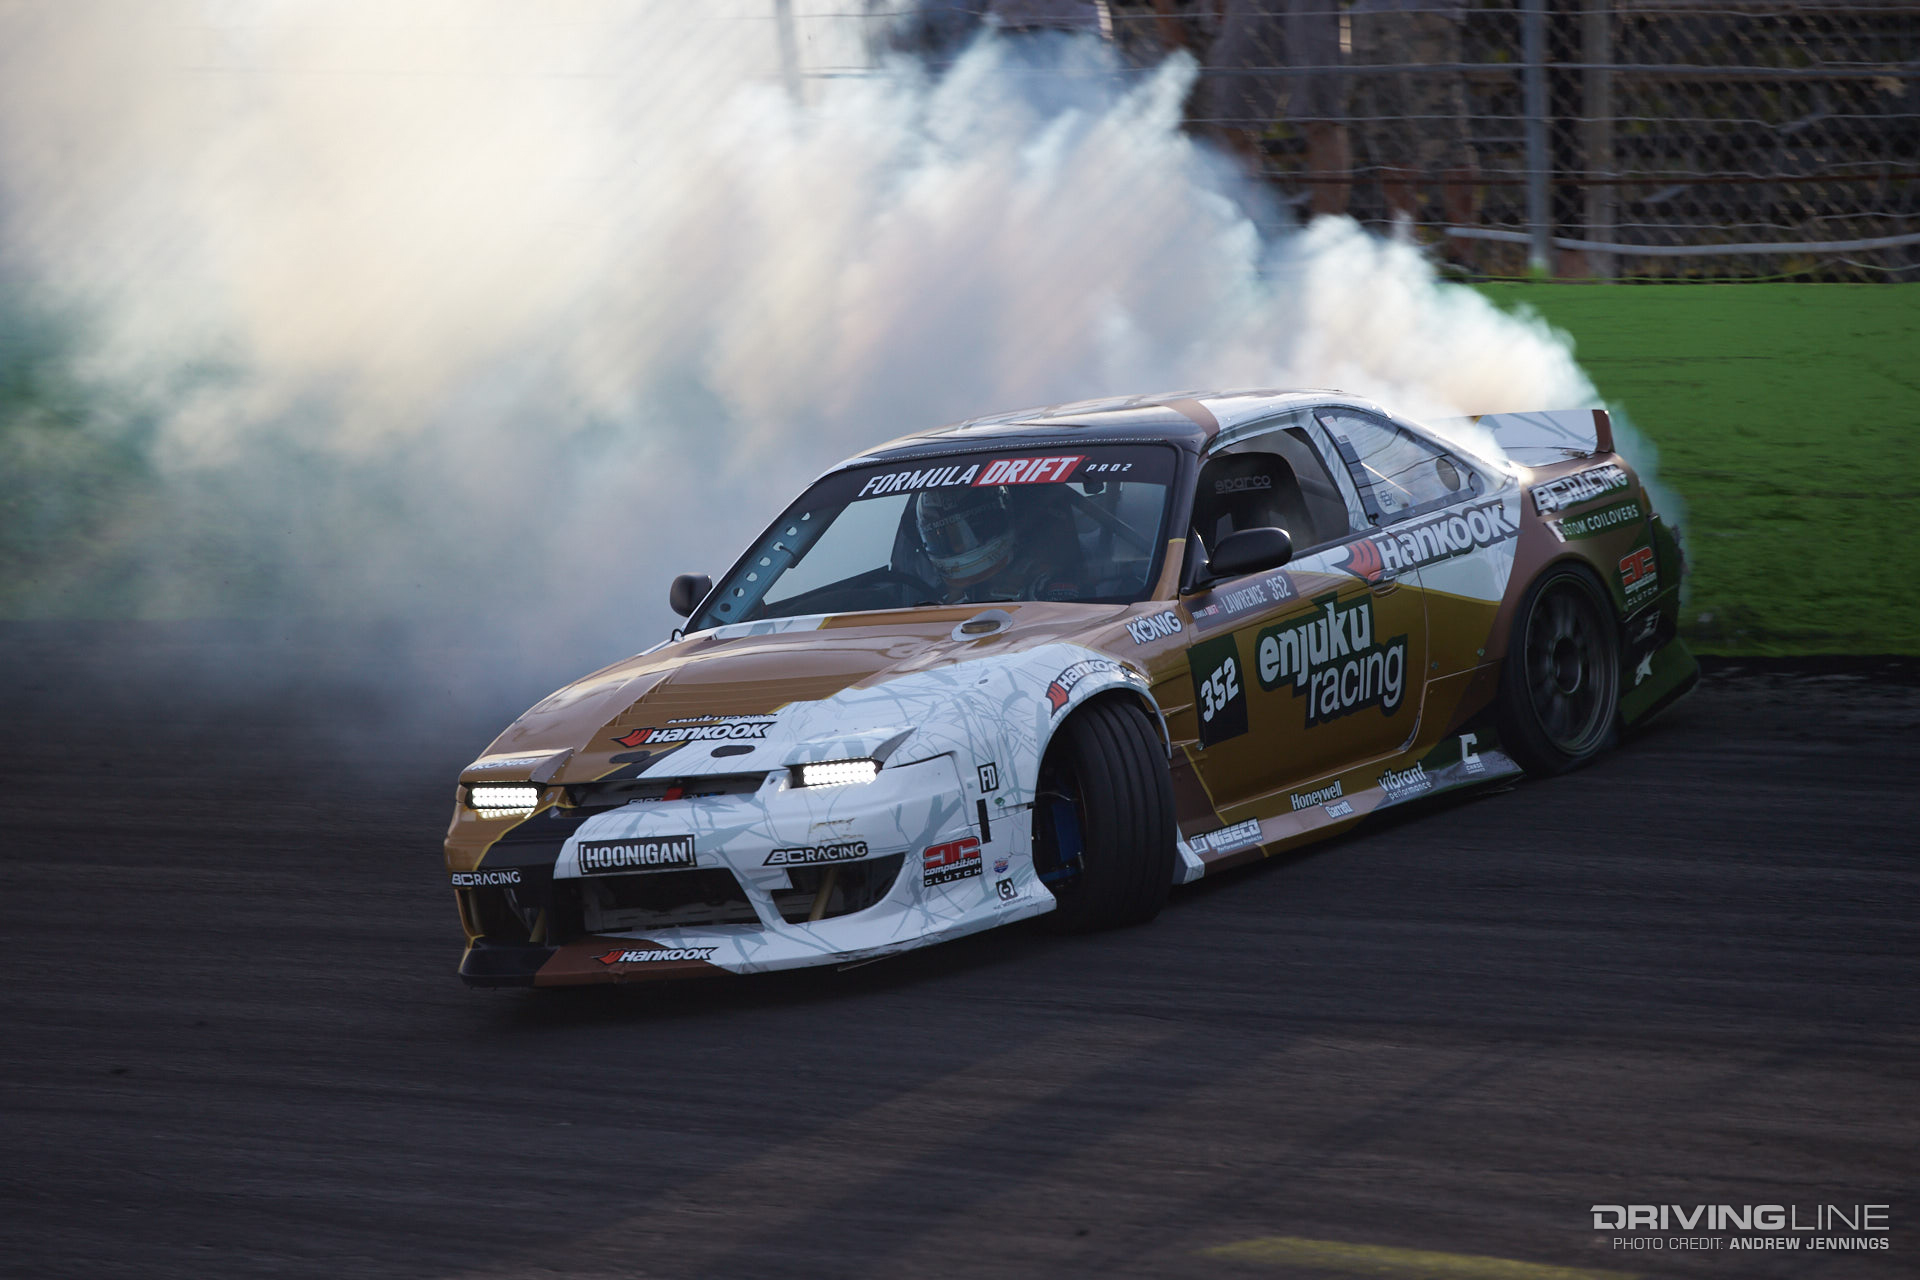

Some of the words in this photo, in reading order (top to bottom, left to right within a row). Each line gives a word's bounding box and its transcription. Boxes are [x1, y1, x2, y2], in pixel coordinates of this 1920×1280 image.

[858, 464, 980, 498] FORMULA
[978, 456, 1079, 485] DRIFT
[1587, 504, 1640, 531] COILOVERS
[1220, 584, 1268, 615] LAWRENCE
[1266, 575, 1292, 601] 352
[1627, 585, 1658, 607] CLUTCH
[1259, 601, 1371, 687] enjuku
[1200, 656, 1239, 722] 352
[1309, 645, 1404, 719] racing
[979, 765, 997, 791] FD
[1378, 761, 1427, 792] vibrant
[1290, 780, 1343, 810] Honeywell
[1388, 781, 1432, 801] performance
[1325, 801, 1353, 818] Garrett
[924, 857, 981, 876] competition
[925, 868, 982, 886] CLUTCH
